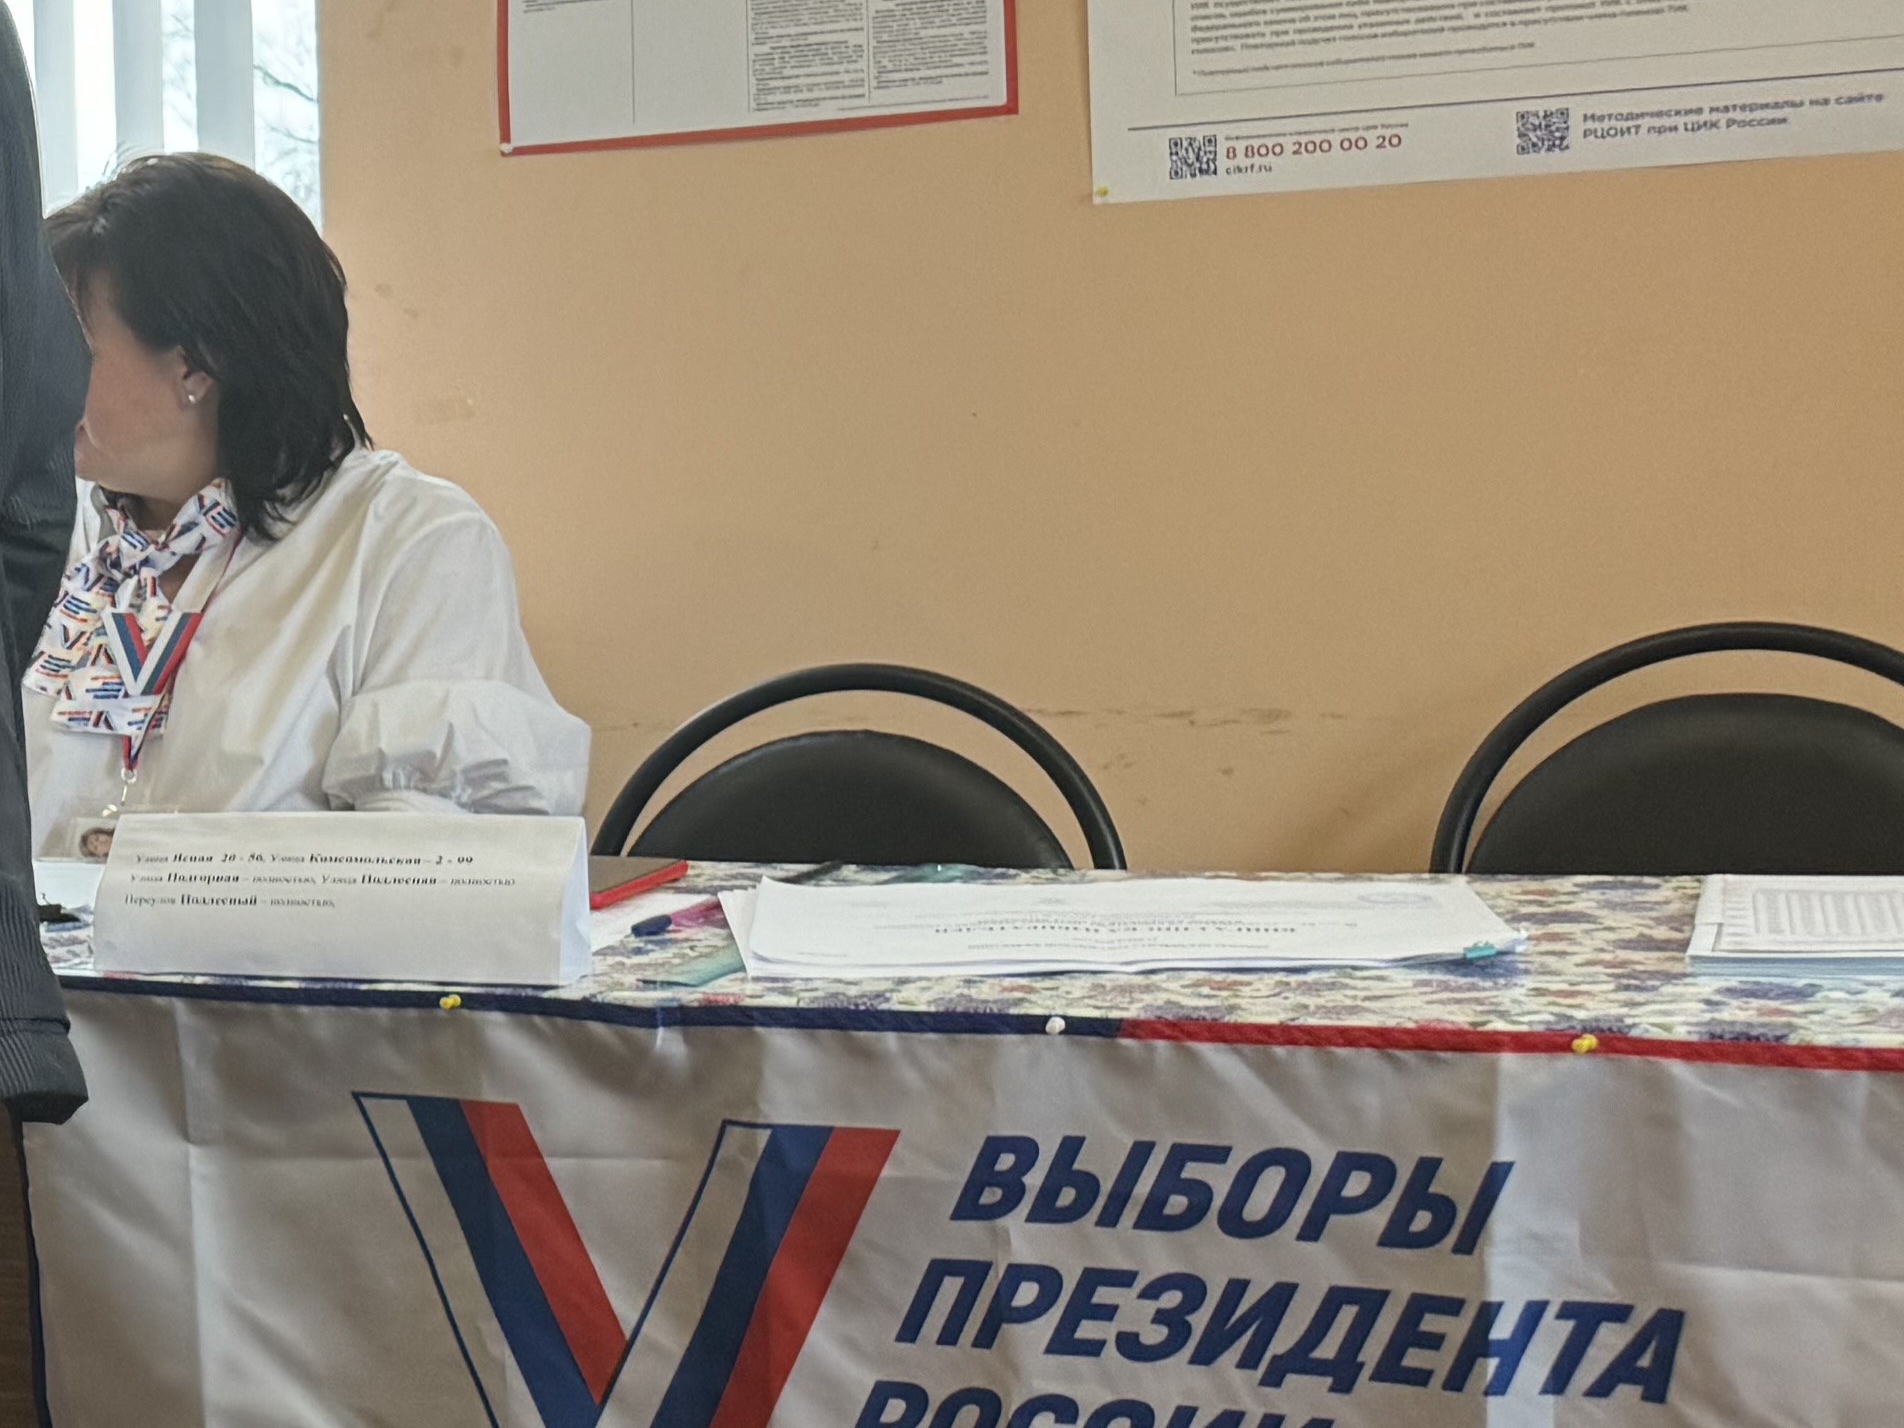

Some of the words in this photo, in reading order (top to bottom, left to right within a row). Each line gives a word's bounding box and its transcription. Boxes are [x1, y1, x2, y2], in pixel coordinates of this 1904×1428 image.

[1583, 106, 1703, 124] Методические
[1709, 99, 1804, 117] материалы
[1809, 97, 1830, 107] на
[1835, 91, 1885, 105] сайте
[1583, 123, 1641, 140] РЦОИТ
[1647, 121, 1679, 137] при
[1684, 119, 1721, 135] ЦИК
[1725, 115, 1789, 131] России
[1225, 146, 1237, 161] 8
[1244, 143, 1284, 159] 800
[1292, 139, 1332, 156] 200
[1340, 136, 1368, 152] 00
[1375, 133, 1402, 149] 20
[948, 1134, 1515, 1257] ВЫБОРЫ
[893, 1256, 1686, 1405] ПРЕЗИДЕНТА
